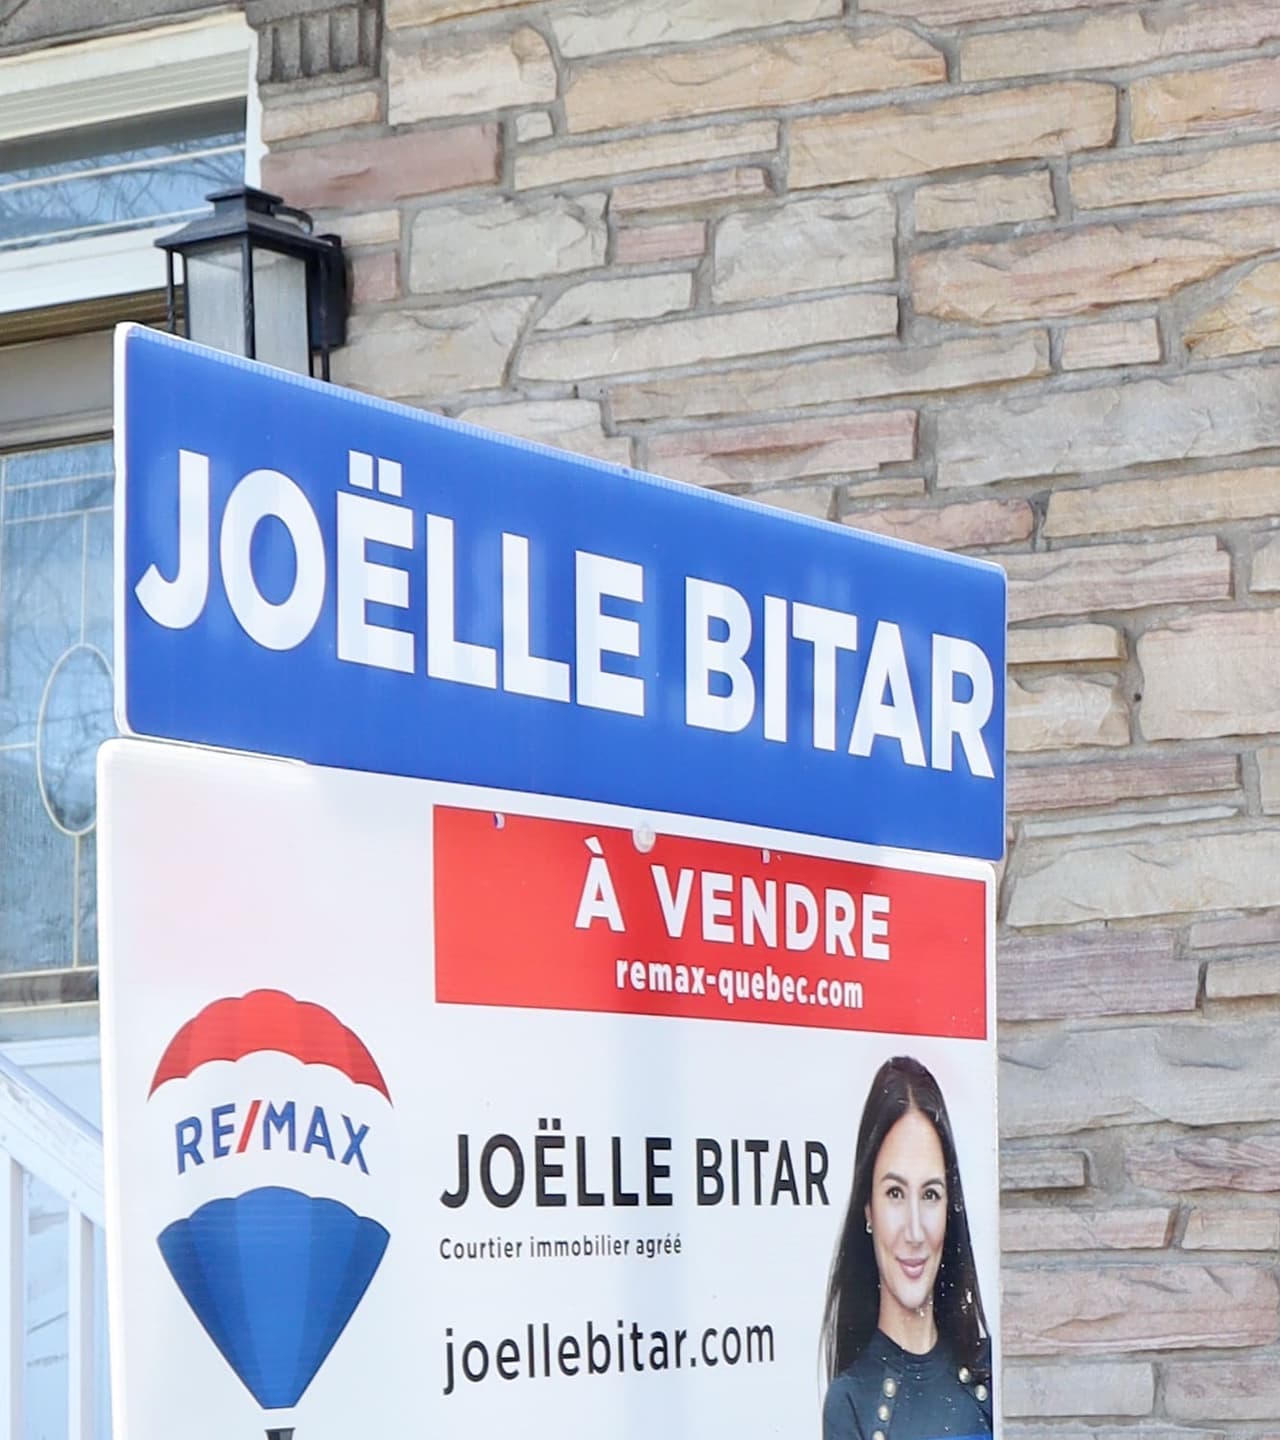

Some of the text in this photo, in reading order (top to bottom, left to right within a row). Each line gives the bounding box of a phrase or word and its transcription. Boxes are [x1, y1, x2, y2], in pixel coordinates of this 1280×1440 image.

[134, 447, 995, 779] JOËLLE BITAR
[575, 836, 892, 961] À VENDRE
[615, 957, 864, 1009] remax-quebec.com
[174, 1098, 371, 1177] RE/MAX
[440, 1119, 830, 1211] JOËLLE BITAR
[440, 1232, 683, 1261] Courtier immobilier agréé
[442, 1319, 776, 1396] joellebitar.com
